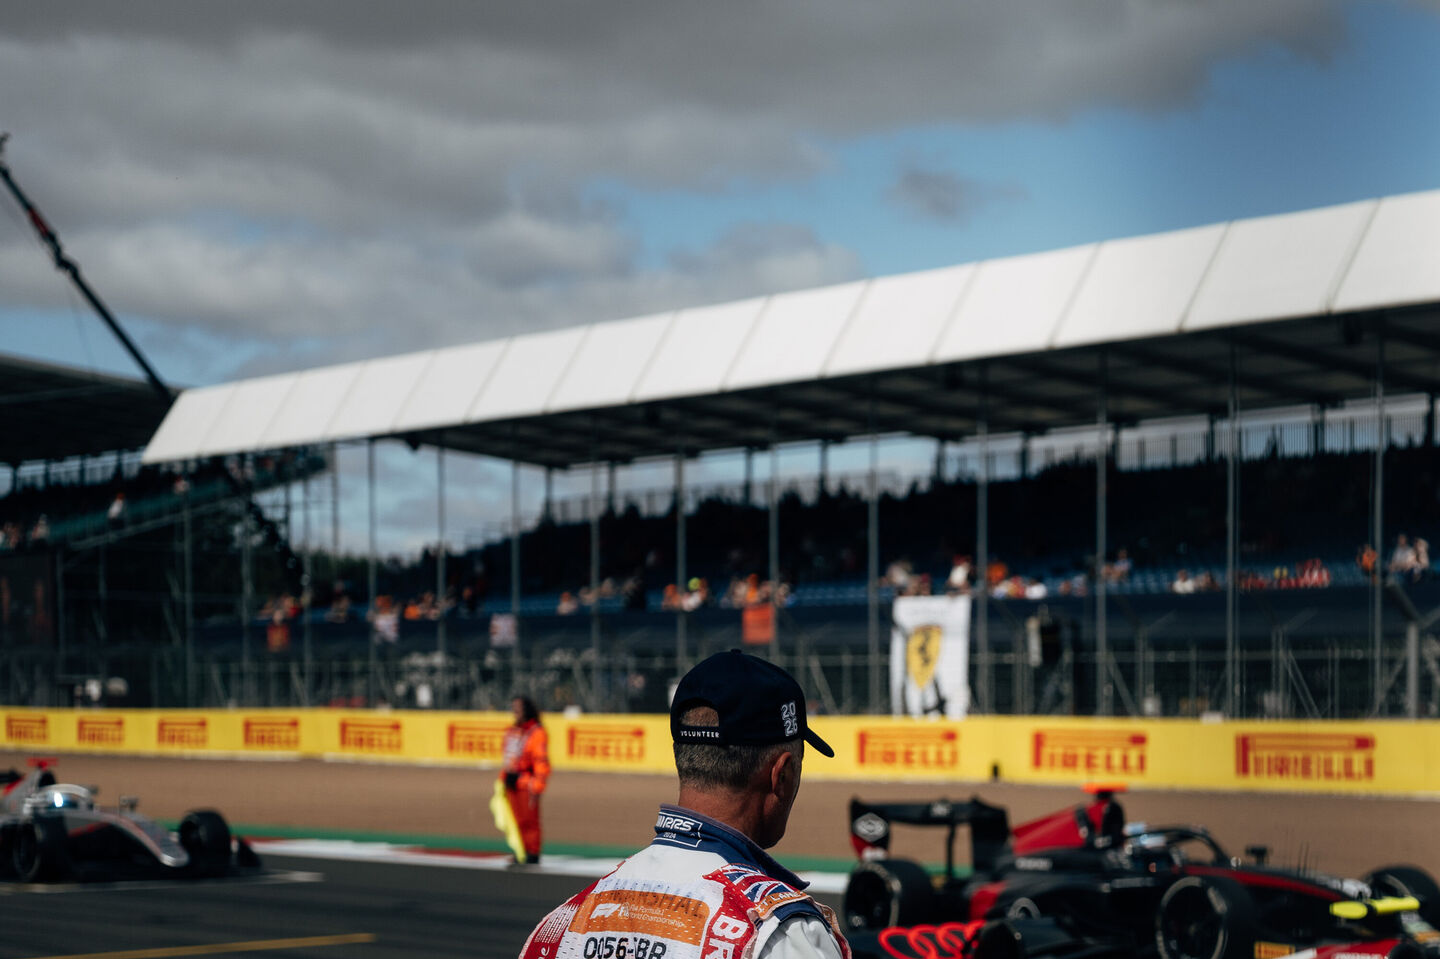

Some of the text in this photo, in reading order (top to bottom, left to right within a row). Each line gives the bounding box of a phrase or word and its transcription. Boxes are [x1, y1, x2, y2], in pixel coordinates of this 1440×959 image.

[680, 730, 719, 738] VOLUNTEER
[857, 728, 959, 769] PIRELLI
[1033, 729, 1148, 775] PIRELLI
[1235, 732, 1377, 781] PIRELLI
